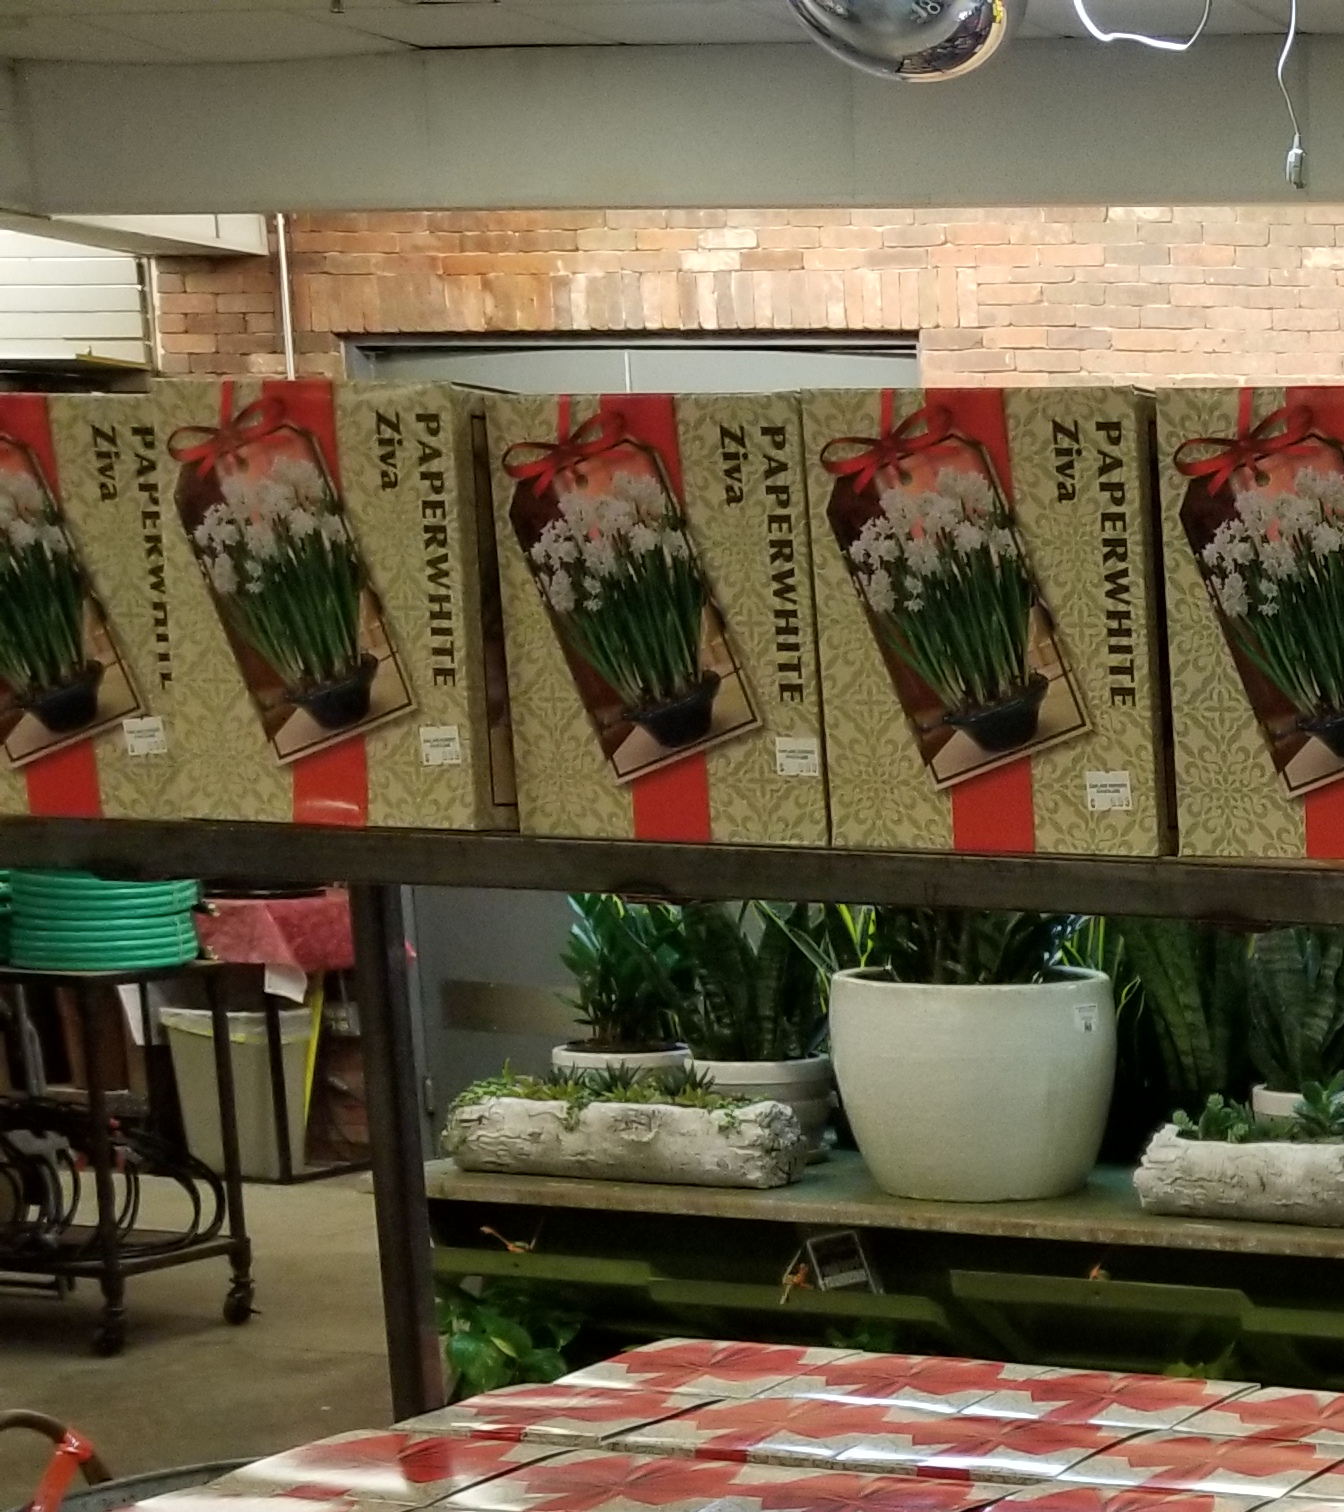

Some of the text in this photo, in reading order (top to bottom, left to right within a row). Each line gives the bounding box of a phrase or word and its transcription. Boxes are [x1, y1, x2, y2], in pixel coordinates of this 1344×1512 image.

[91, 424, 119, 502] Ziva
[376, 409, 403, 491] Ziva
[720, 425, 744, 506] Ziva
[1051, 419, 1079, 504] Ziva
[414, 412, 455, 687] PAPERWHITE
[760, 426, 804, 703] PAPERWHITE
[1096, 420, 1136, 707] PAPERWHITE
